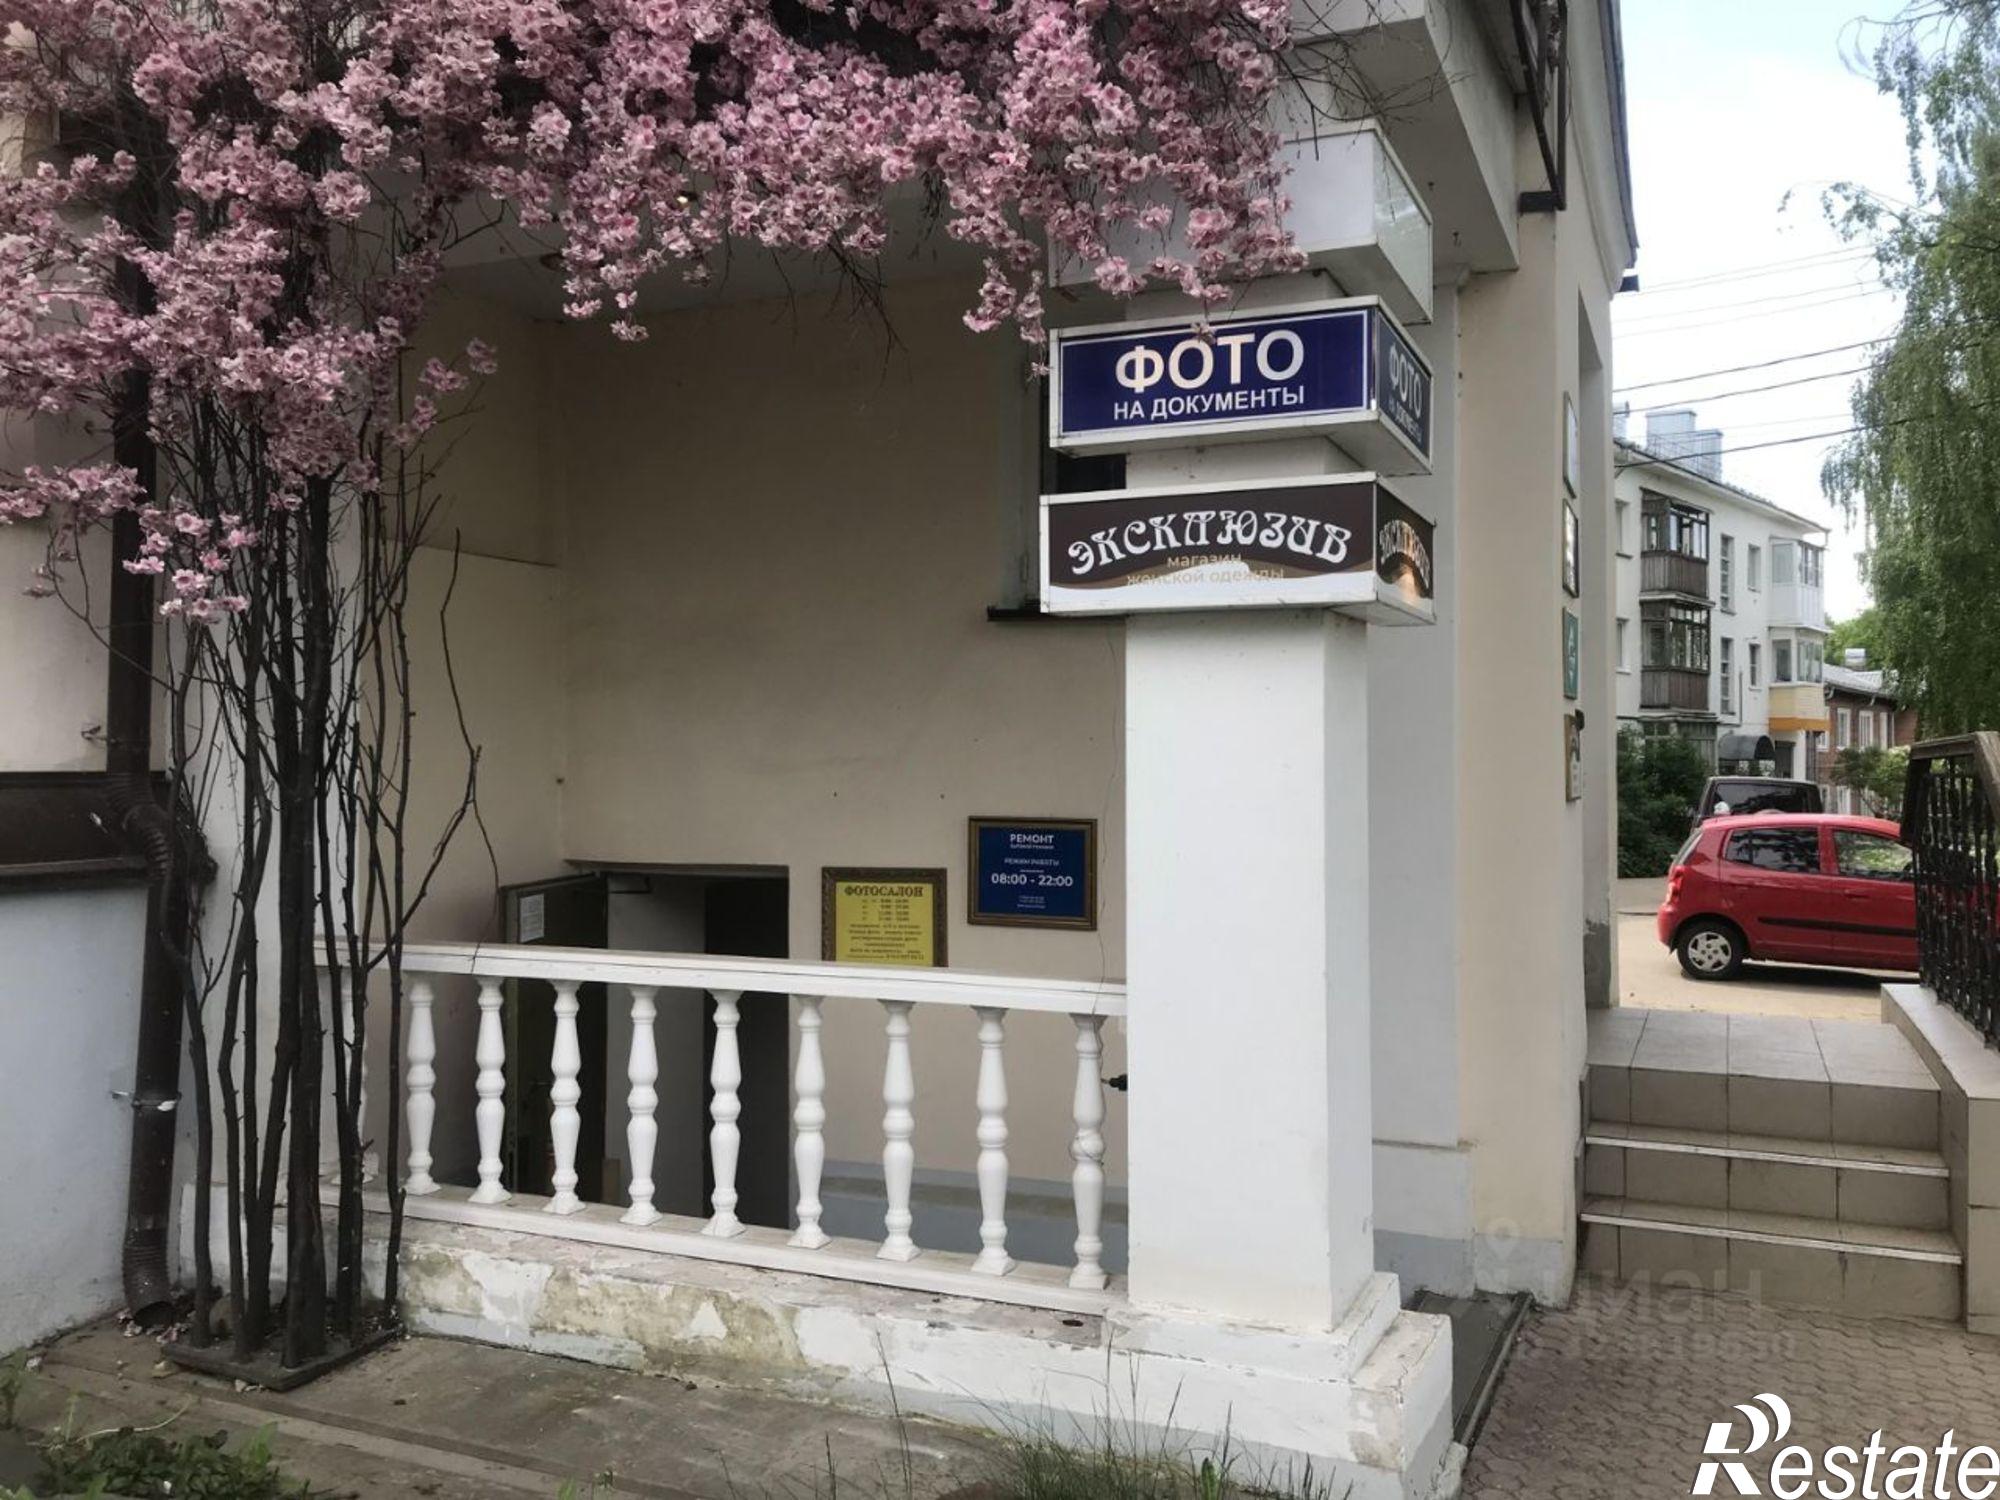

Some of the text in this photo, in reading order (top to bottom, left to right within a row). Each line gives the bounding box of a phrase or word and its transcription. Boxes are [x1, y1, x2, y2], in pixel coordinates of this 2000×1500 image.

[1115, 329, 1305, 393] ФОТО
[1389, 342, 1422, 419] ФОТО
[1113, 385, 1305, 420] НА ДОКУМЕНТЫ
[1067, 510, 1353, 575] ЭКСКЛЮЗИВ
[1167, 552, 1242, 568] магазин
[1127, 568, 1285, 586] женской одежды
[1010, 833, 1054, 844] РЕМОНТ
[991, 872, 1027, 885] 08:00
[1038, 874, 1073, 887] 22:00
[844, 885, 924, 898] ФОТОСАЛОН
